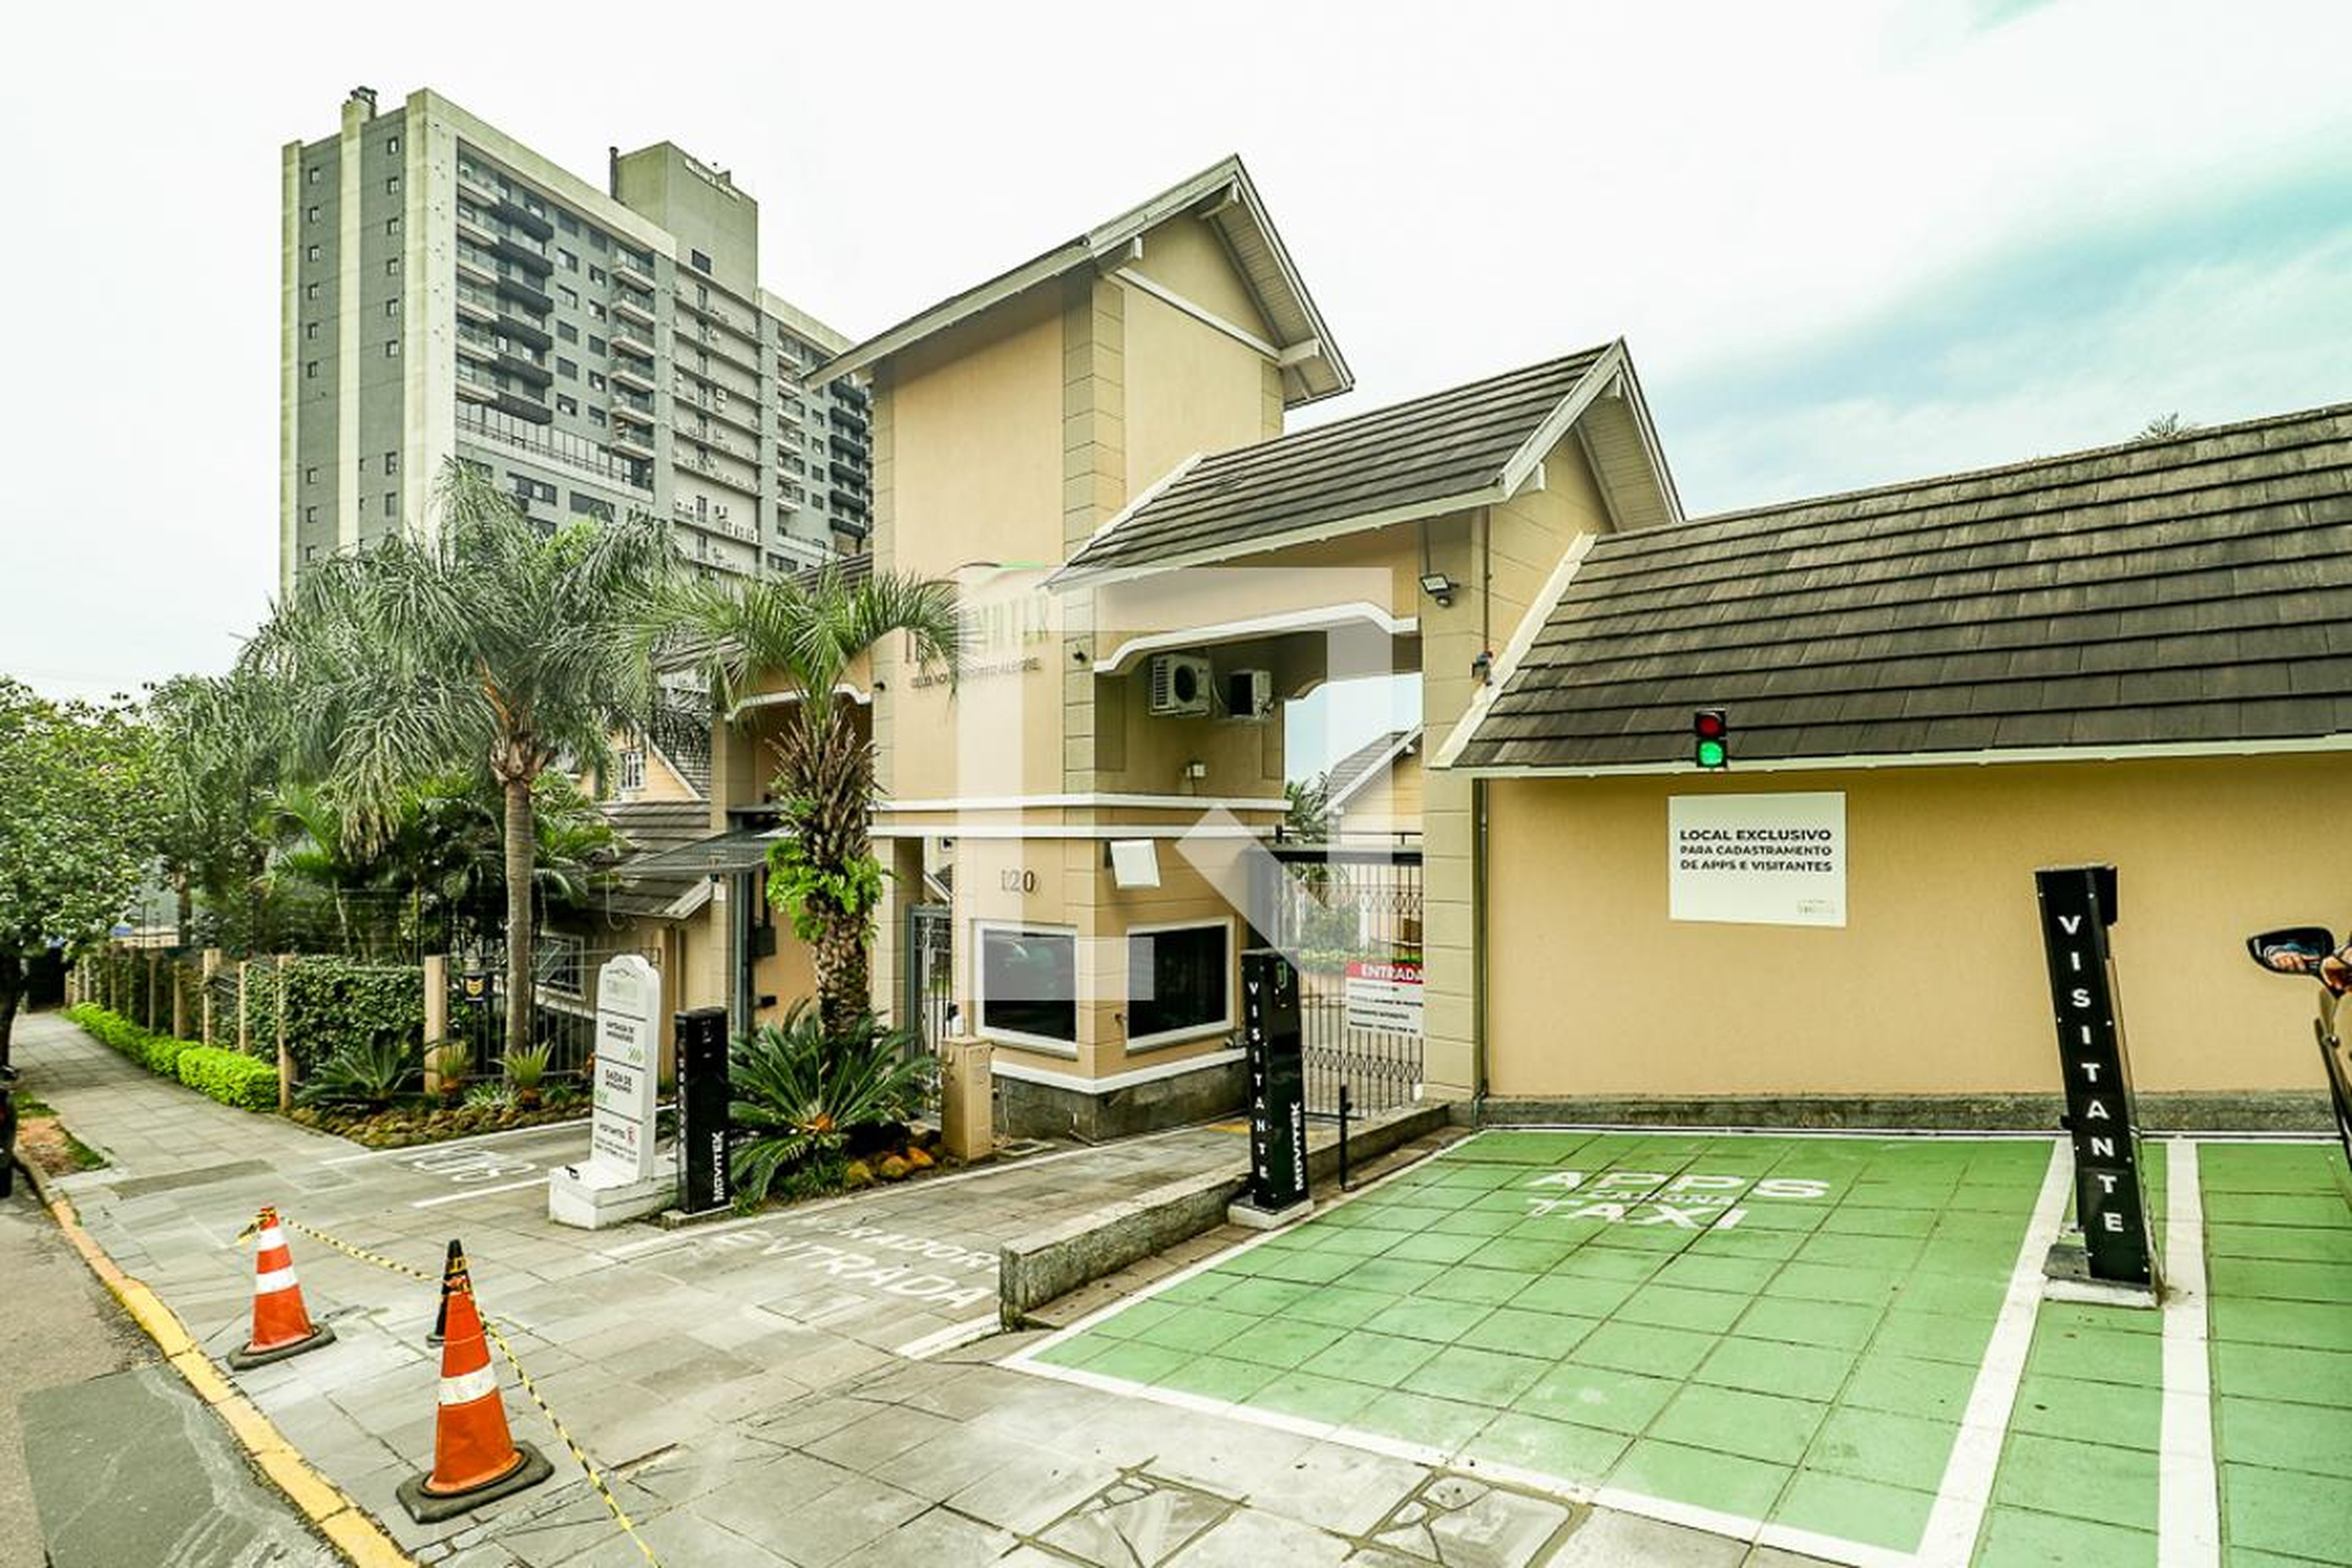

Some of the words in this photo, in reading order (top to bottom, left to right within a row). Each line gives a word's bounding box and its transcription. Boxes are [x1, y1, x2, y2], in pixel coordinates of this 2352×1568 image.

[1680, 830, 1732, 840] LOCAL
[1737, 830, 1831, 840] EXCLUSIVO
[1680, 846, 1713, 854] PARA
[1716, 846, 1832, 856] CADASTRAMENTO
[1681, 860, 1698, 870] DE
[1702, 861, 1736, 870] APPS
[1740, 861, 1747, 870] E
[1751, 861, 1832, 872] VISITANTES
[1001, 870, 1034, 892] 120
[2059, 916, 2123, 1232] VISITANTE
[1525, 1171, 1830, 1198] APPS
[1528, 1199, 1747, 1230] TAXI
